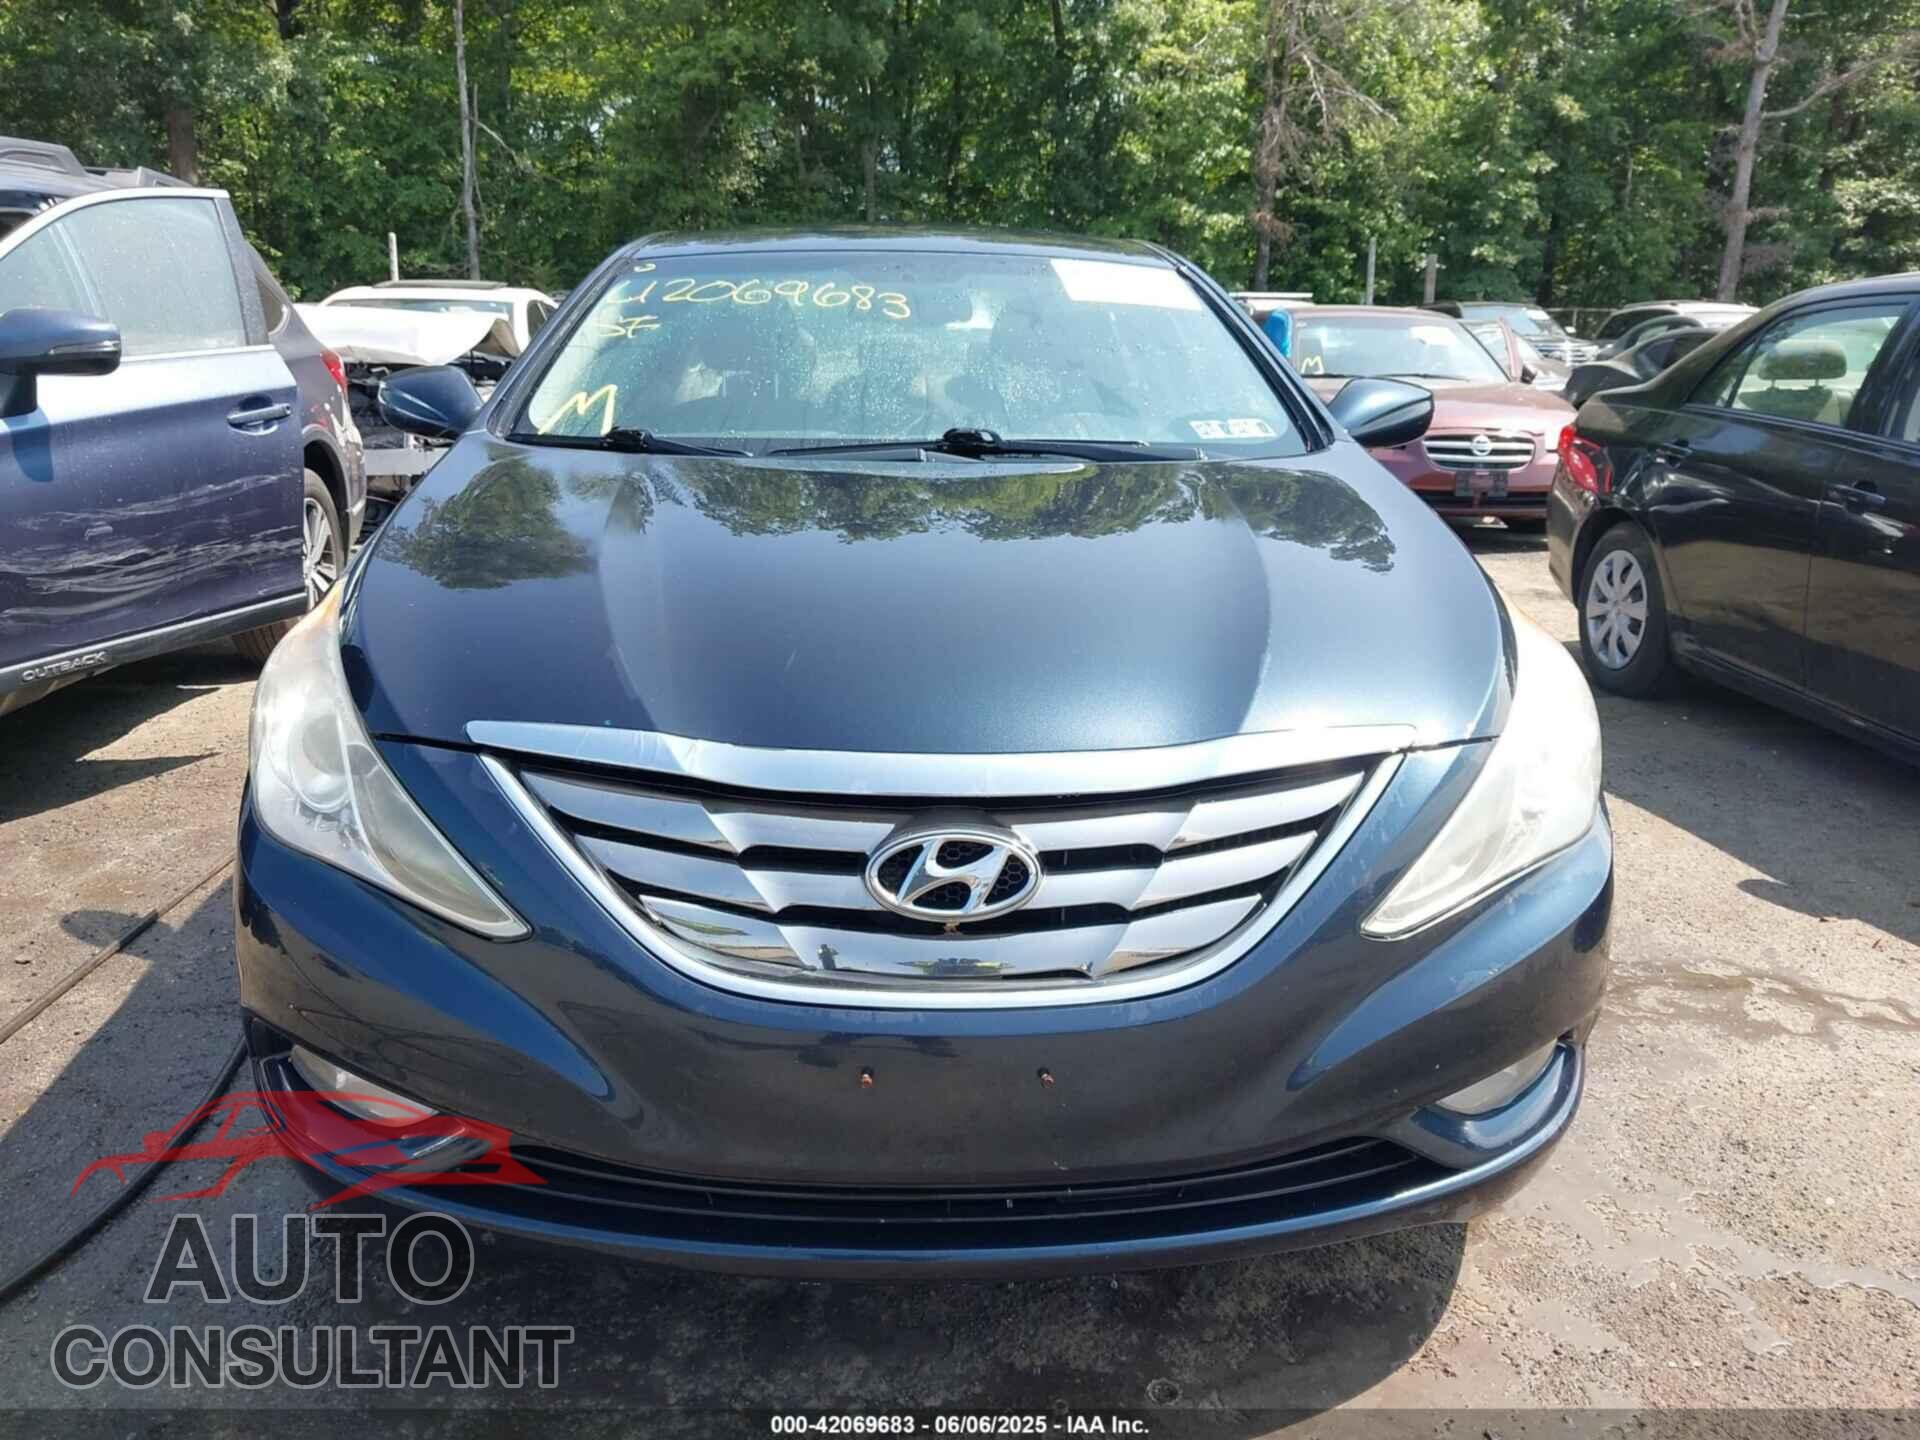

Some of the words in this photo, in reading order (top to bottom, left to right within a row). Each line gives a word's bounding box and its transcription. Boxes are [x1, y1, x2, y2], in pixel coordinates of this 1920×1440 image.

[1300, 355, 1325, 375] M
[538, 383, 618, 436] M
[22, 651, 106, 681] OUTBACK
